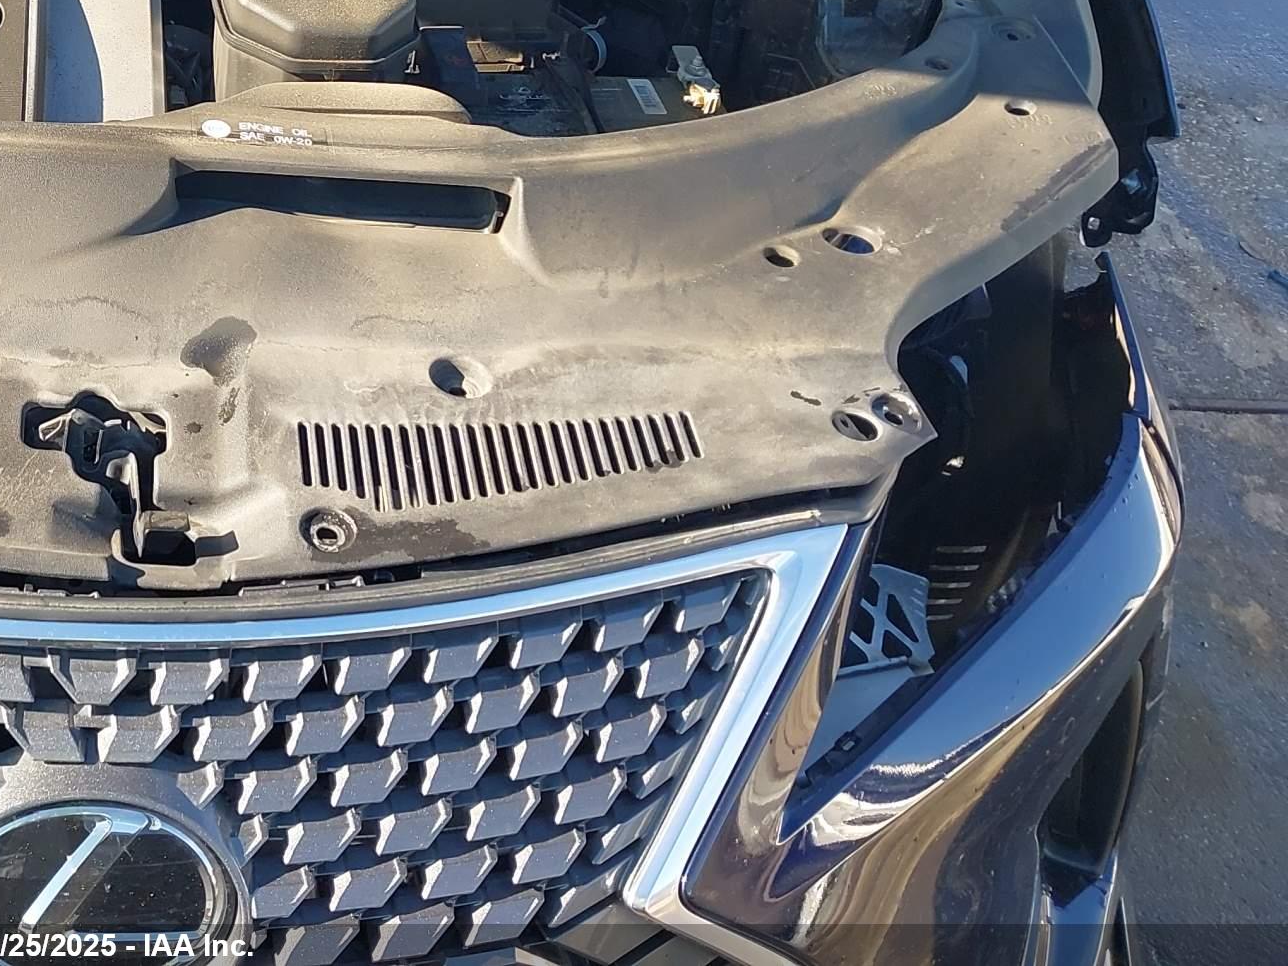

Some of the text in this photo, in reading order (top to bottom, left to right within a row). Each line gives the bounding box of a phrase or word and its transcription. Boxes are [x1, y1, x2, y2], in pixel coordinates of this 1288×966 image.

[238, 122, 313, 138] ENGINE OIL
[239, 132, 313, 147] SAE 0W-20
